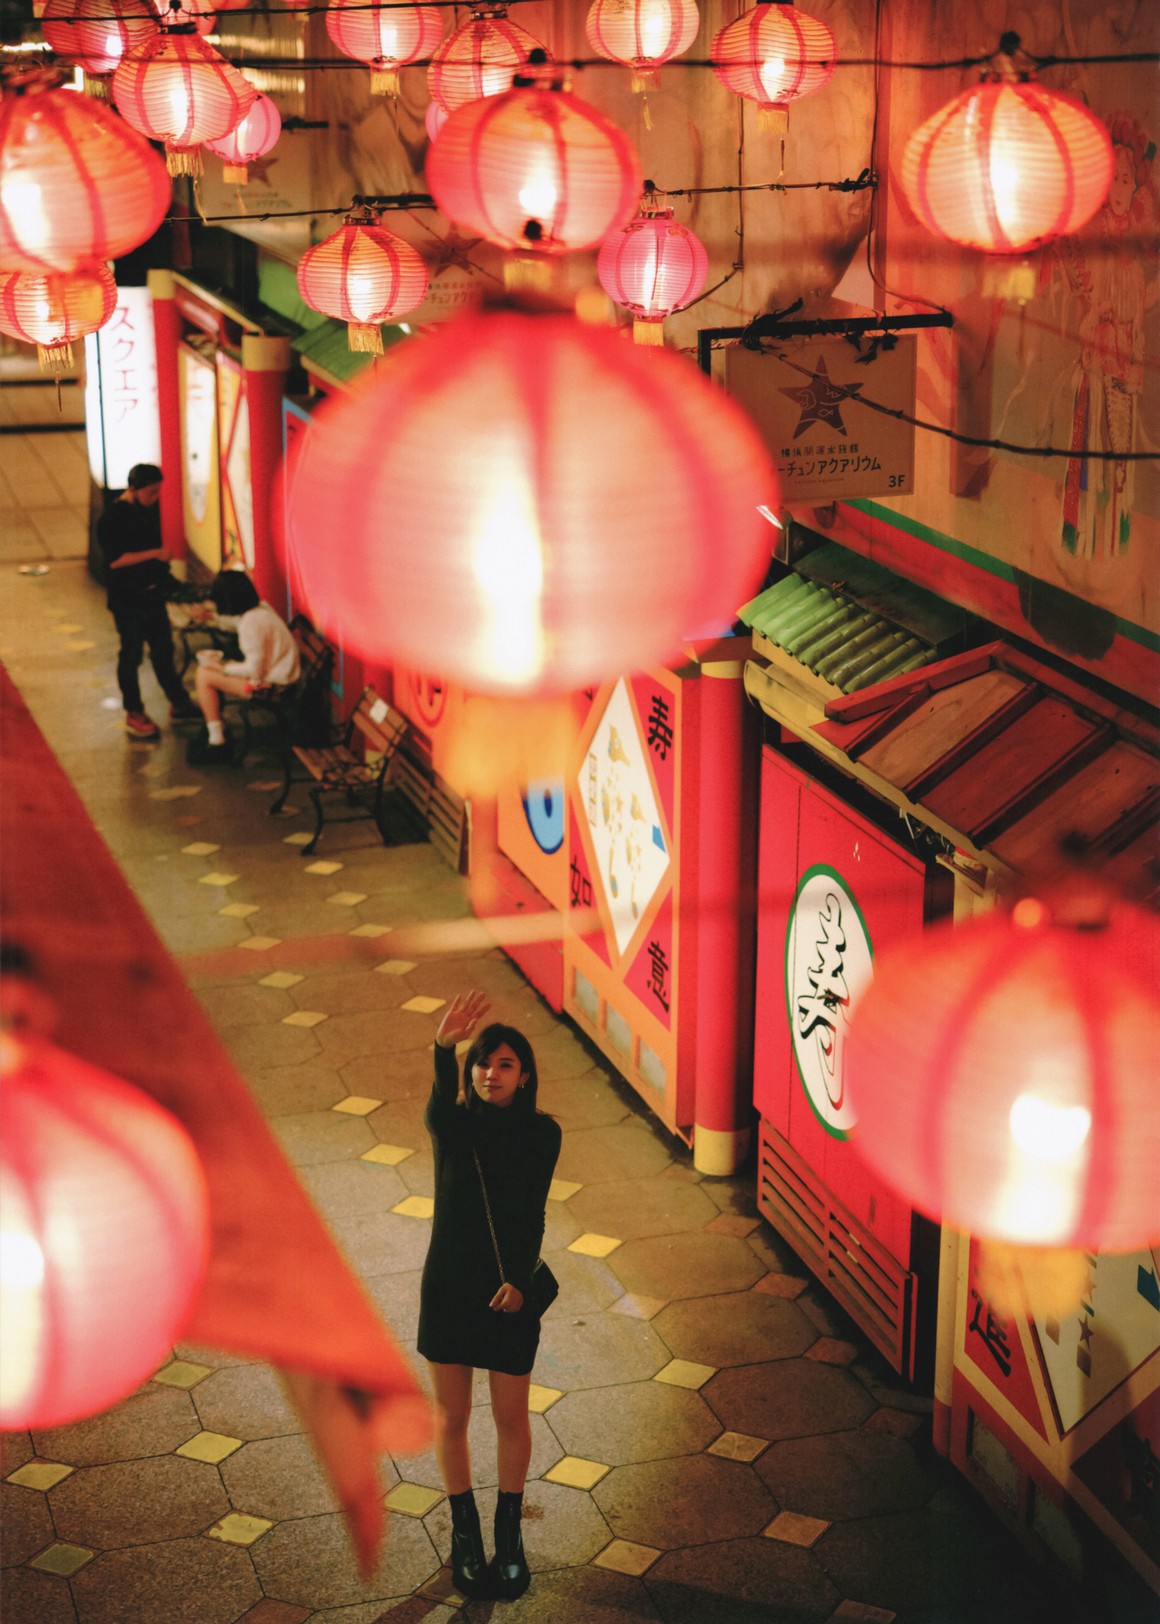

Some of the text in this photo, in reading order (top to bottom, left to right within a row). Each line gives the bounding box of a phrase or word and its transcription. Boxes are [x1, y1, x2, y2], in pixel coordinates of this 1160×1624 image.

[110, 305, 139, 422] スクエア
[888, 475, 905, 488] 3F
[569, 854, 592, 908] 如
[647, 940, 670, 1013] 意
